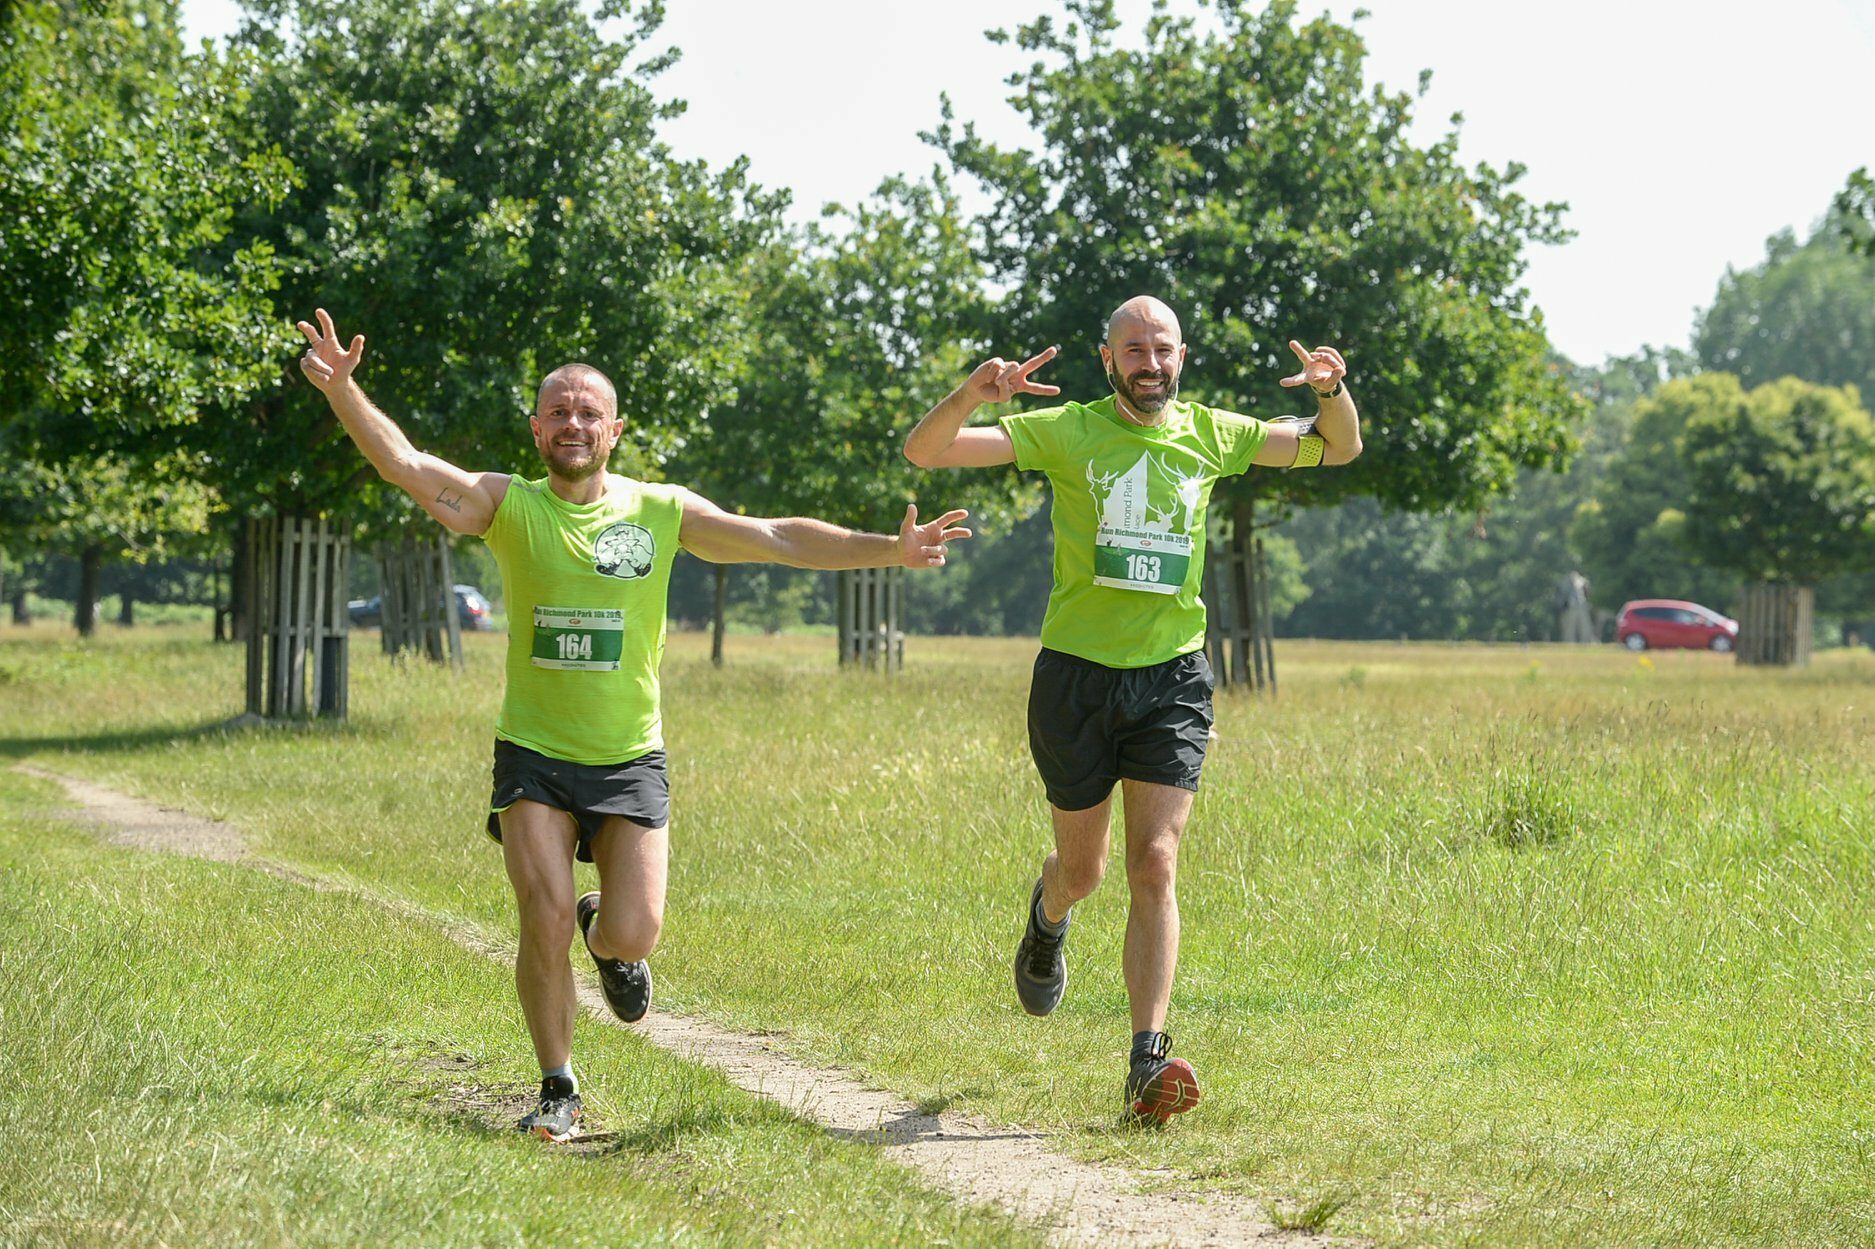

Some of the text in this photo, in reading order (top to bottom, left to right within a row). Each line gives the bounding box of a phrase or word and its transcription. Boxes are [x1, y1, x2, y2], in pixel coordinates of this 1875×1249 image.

[1123, 477, 1133, 498] Park
[1101, 527, 1189, 545] Run Richmond Park 10k 2019
[1126, 554, 1161, 583] 163
[543, 608, 576, 617] Richmond
[577, 610, 592, 618] Park
[556, 633, 593, 660] 164
